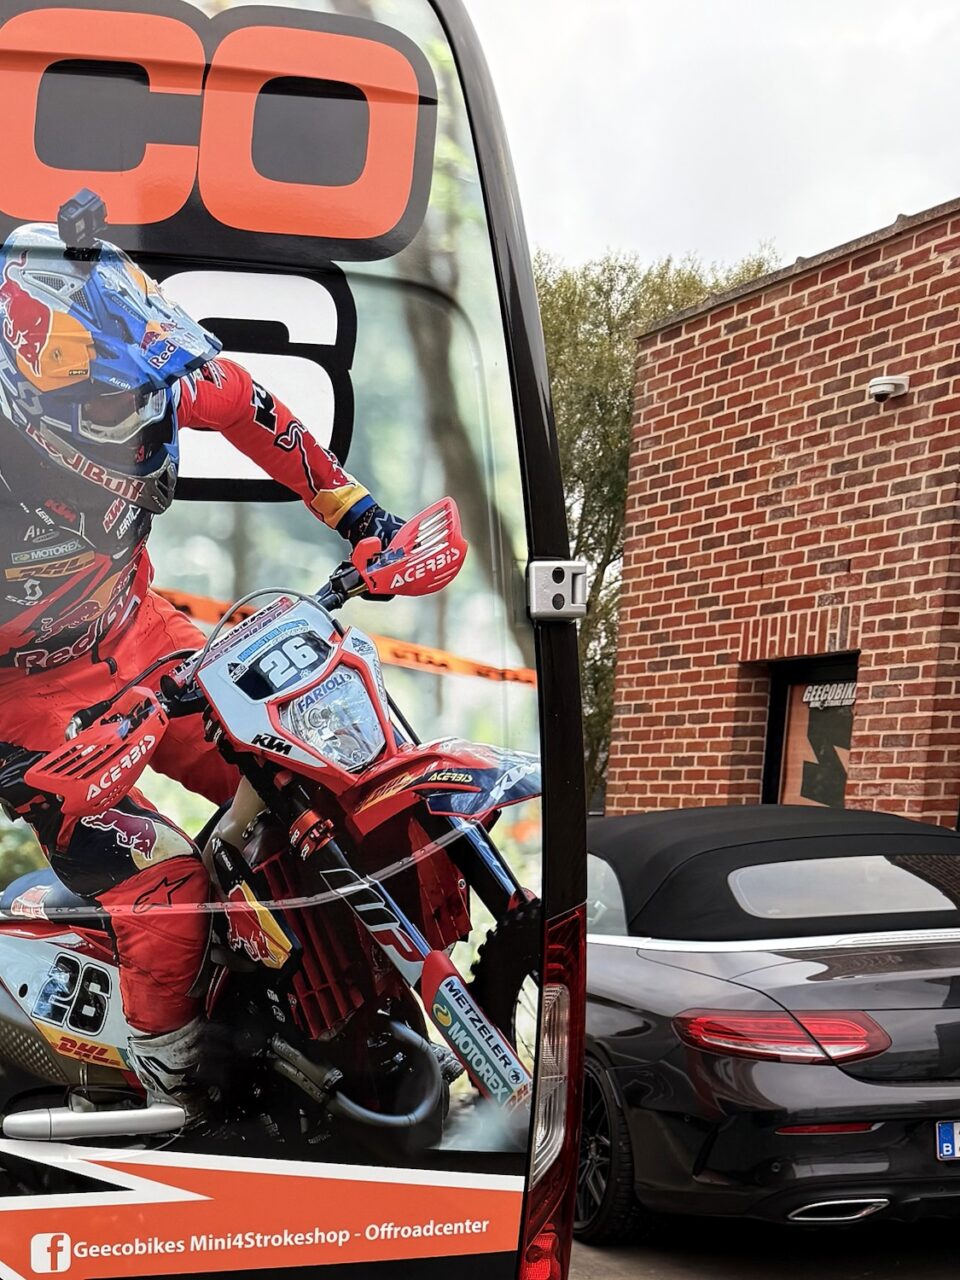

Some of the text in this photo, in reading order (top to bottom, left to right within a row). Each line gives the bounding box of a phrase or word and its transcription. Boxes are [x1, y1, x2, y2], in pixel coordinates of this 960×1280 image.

[148, 339, 178, 370] Red
[31, 540, 82, 560] MOTOREX
[390, 548, 461, 590] ACERBIS
[258, 636, 319, 690] 26
[297, 674, 347, 714] FARIOLI
[251, 733, 293, 756] KTM
[86, 734, 156, 801] ACERBIS
[427, 772, 474, 783] ACERBIS
[30, 951, 113, 1037] 26
[444, 979, 513, 1069] METZELER
[55, 1036, 113, 1063] DHL
[448, 1021, 509, 1101] MOTOREX
[943, 1143, 952, 1155] B
[73, 1239, 185, 1259] Geecobikes
[190, 1227, 350, 1254] Mini4Strokeshop
[364, 1217, 490, 1241] Offroadcenter
